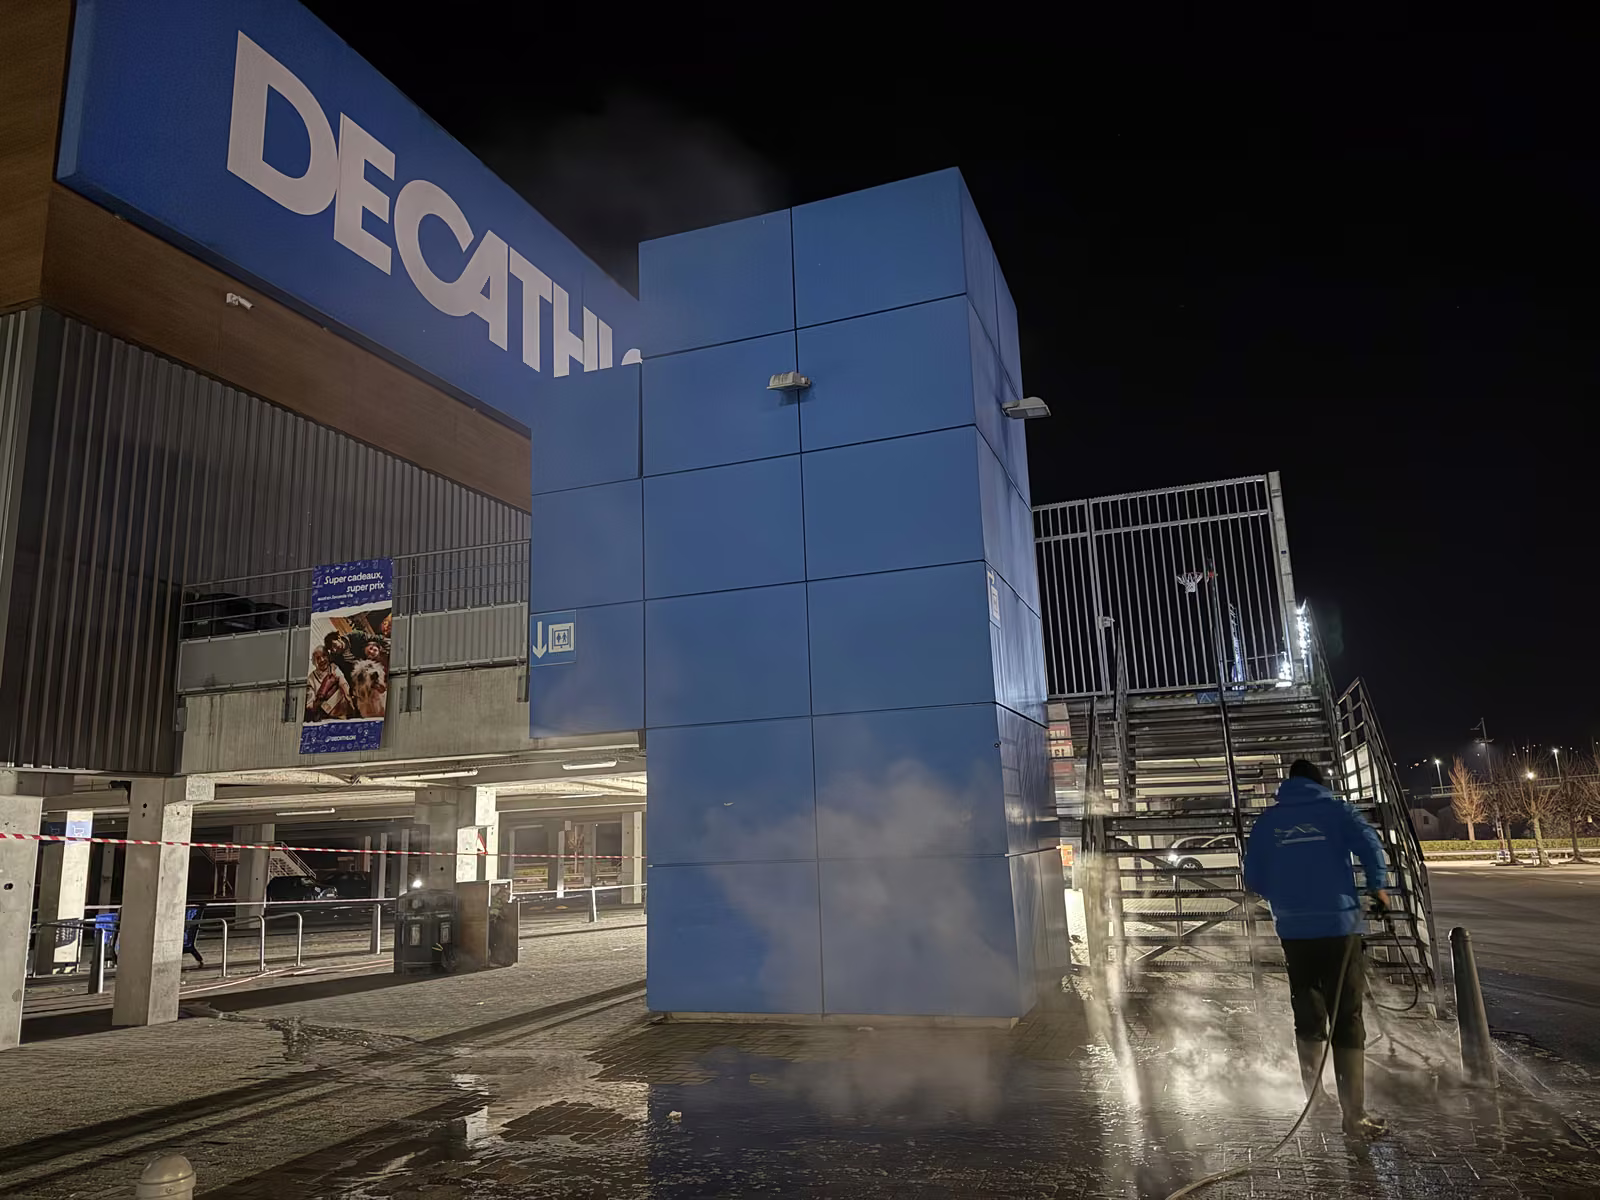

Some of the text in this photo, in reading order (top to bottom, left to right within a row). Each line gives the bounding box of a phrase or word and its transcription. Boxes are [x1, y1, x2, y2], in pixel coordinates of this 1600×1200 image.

[227, 30, 642, 378] DECATH
[323, 572, 383, 585] Super cadeaux,
[346, 581, 385, 594] super prix
